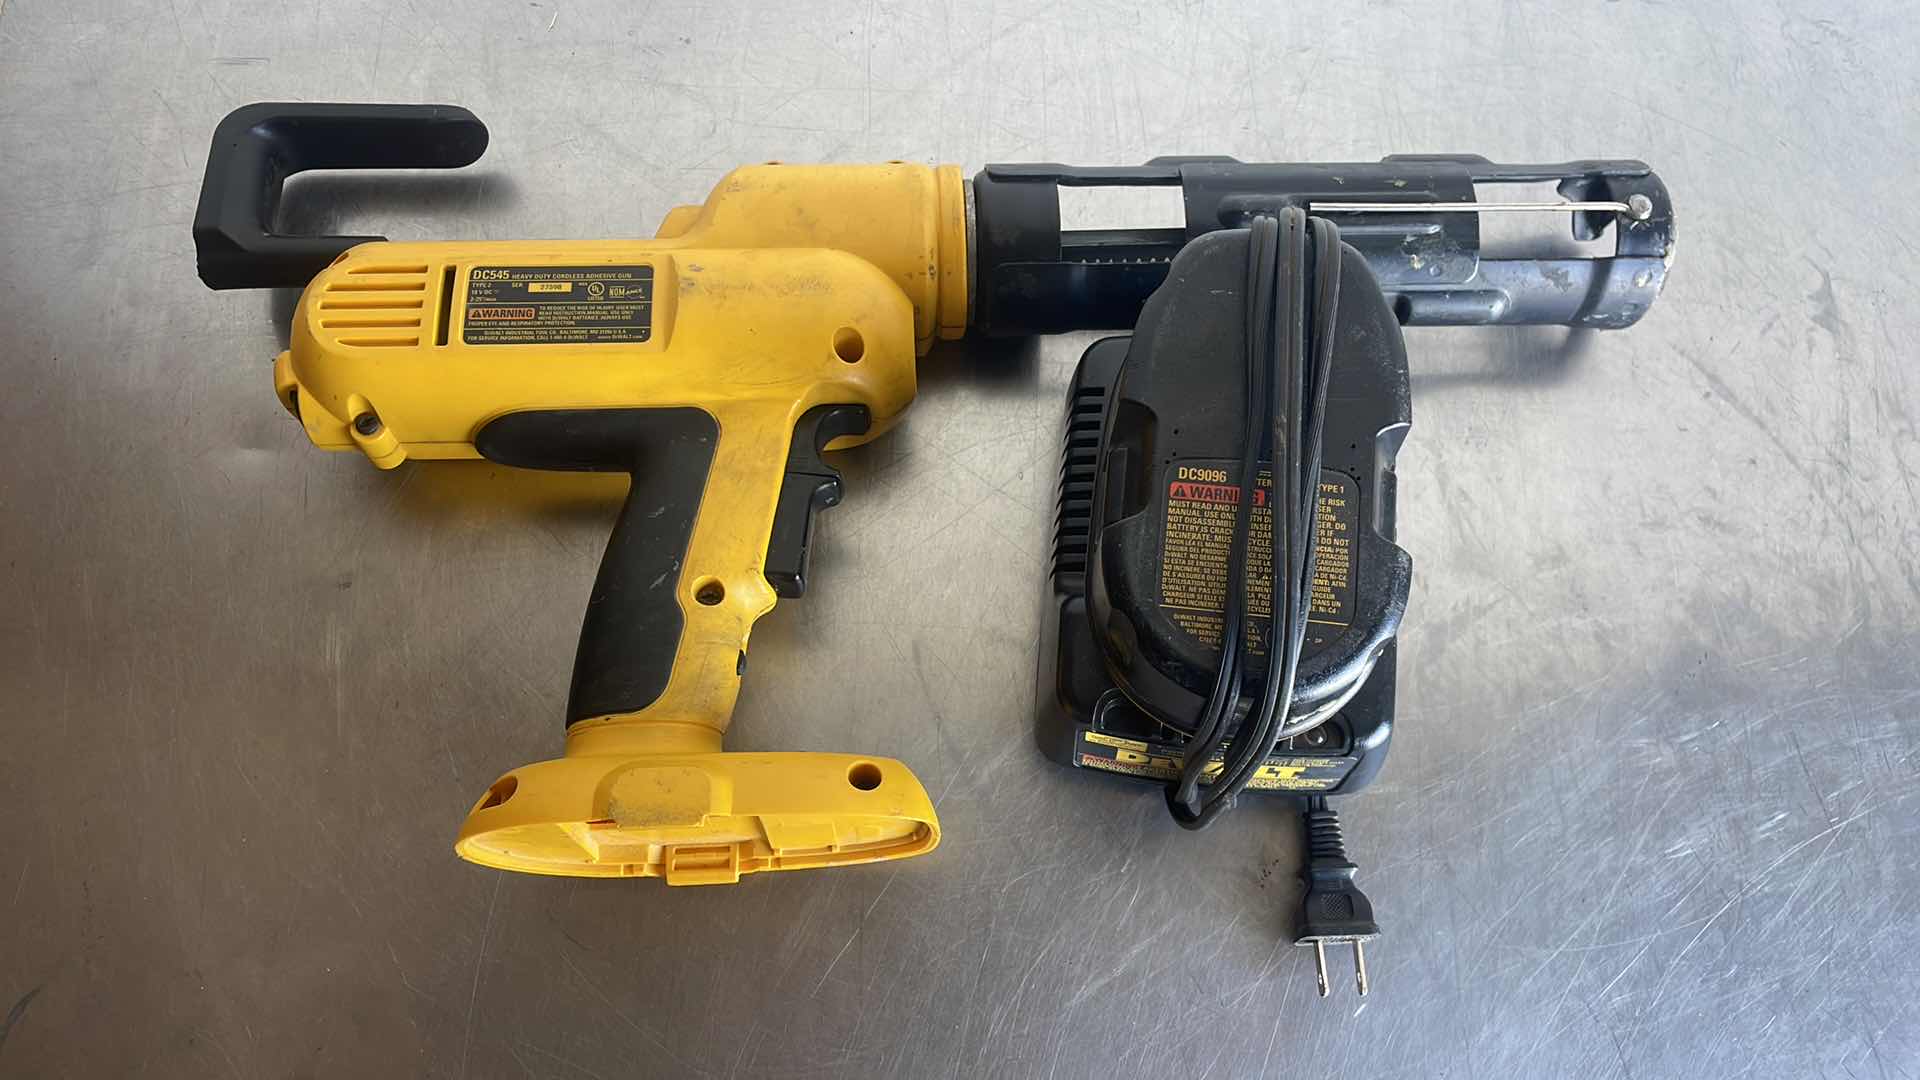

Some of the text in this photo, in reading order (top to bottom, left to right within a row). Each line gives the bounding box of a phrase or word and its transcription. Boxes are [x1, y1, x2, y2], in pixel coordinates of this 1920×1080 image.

[473, 270, 510, 280] DC545
[481, 309, 533, 318] WARNING
[1178, 466, 1227, 483] DC9096
[1168, 500, 1190, 508] MUST
[1192, 502, 1212, 510] READ
[1327, 498, 1345, 506] RISK
[1167, 515, 1183, 523] NOT
[1184, 516, 1236, 527] DISASSEMBL
[1334, 522, 1346, 530] DO
[1167, 522, 1199, 532] BATTERY
[1334, 538, 1350, 546] NOT
